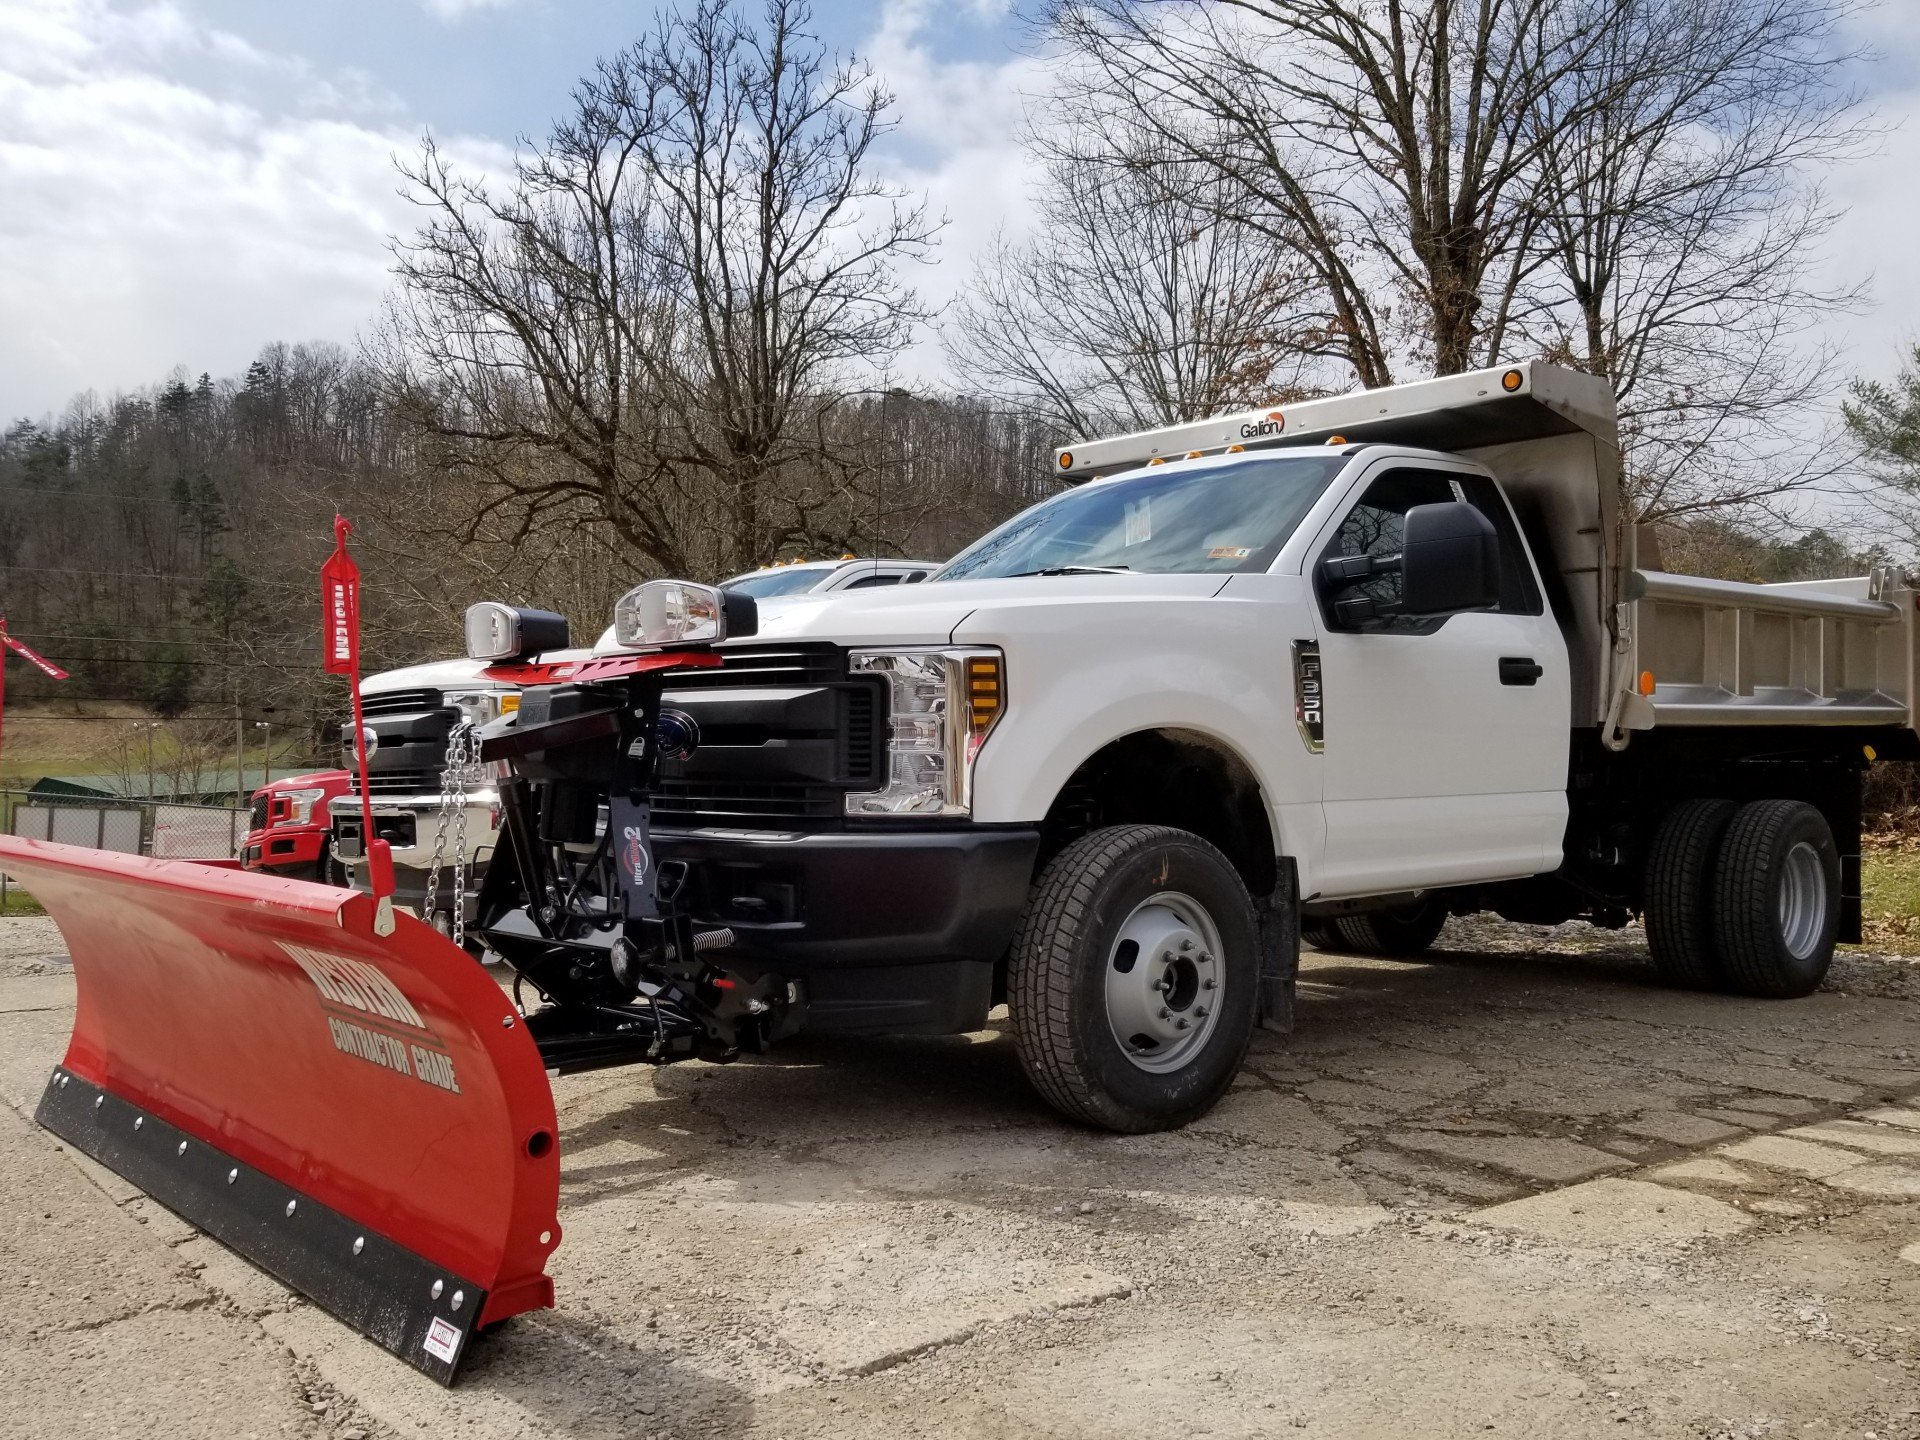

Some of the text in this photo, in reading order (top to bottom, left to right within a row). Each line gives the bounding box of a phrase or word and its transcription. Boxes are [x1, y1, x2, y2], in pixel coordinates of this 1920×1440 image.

[1240, 420, 1279, 439] Galion
[272, 939, 428, 1030] WESTERN
[327, 1016, 462, 1094] CONTRACTOR GRADE
